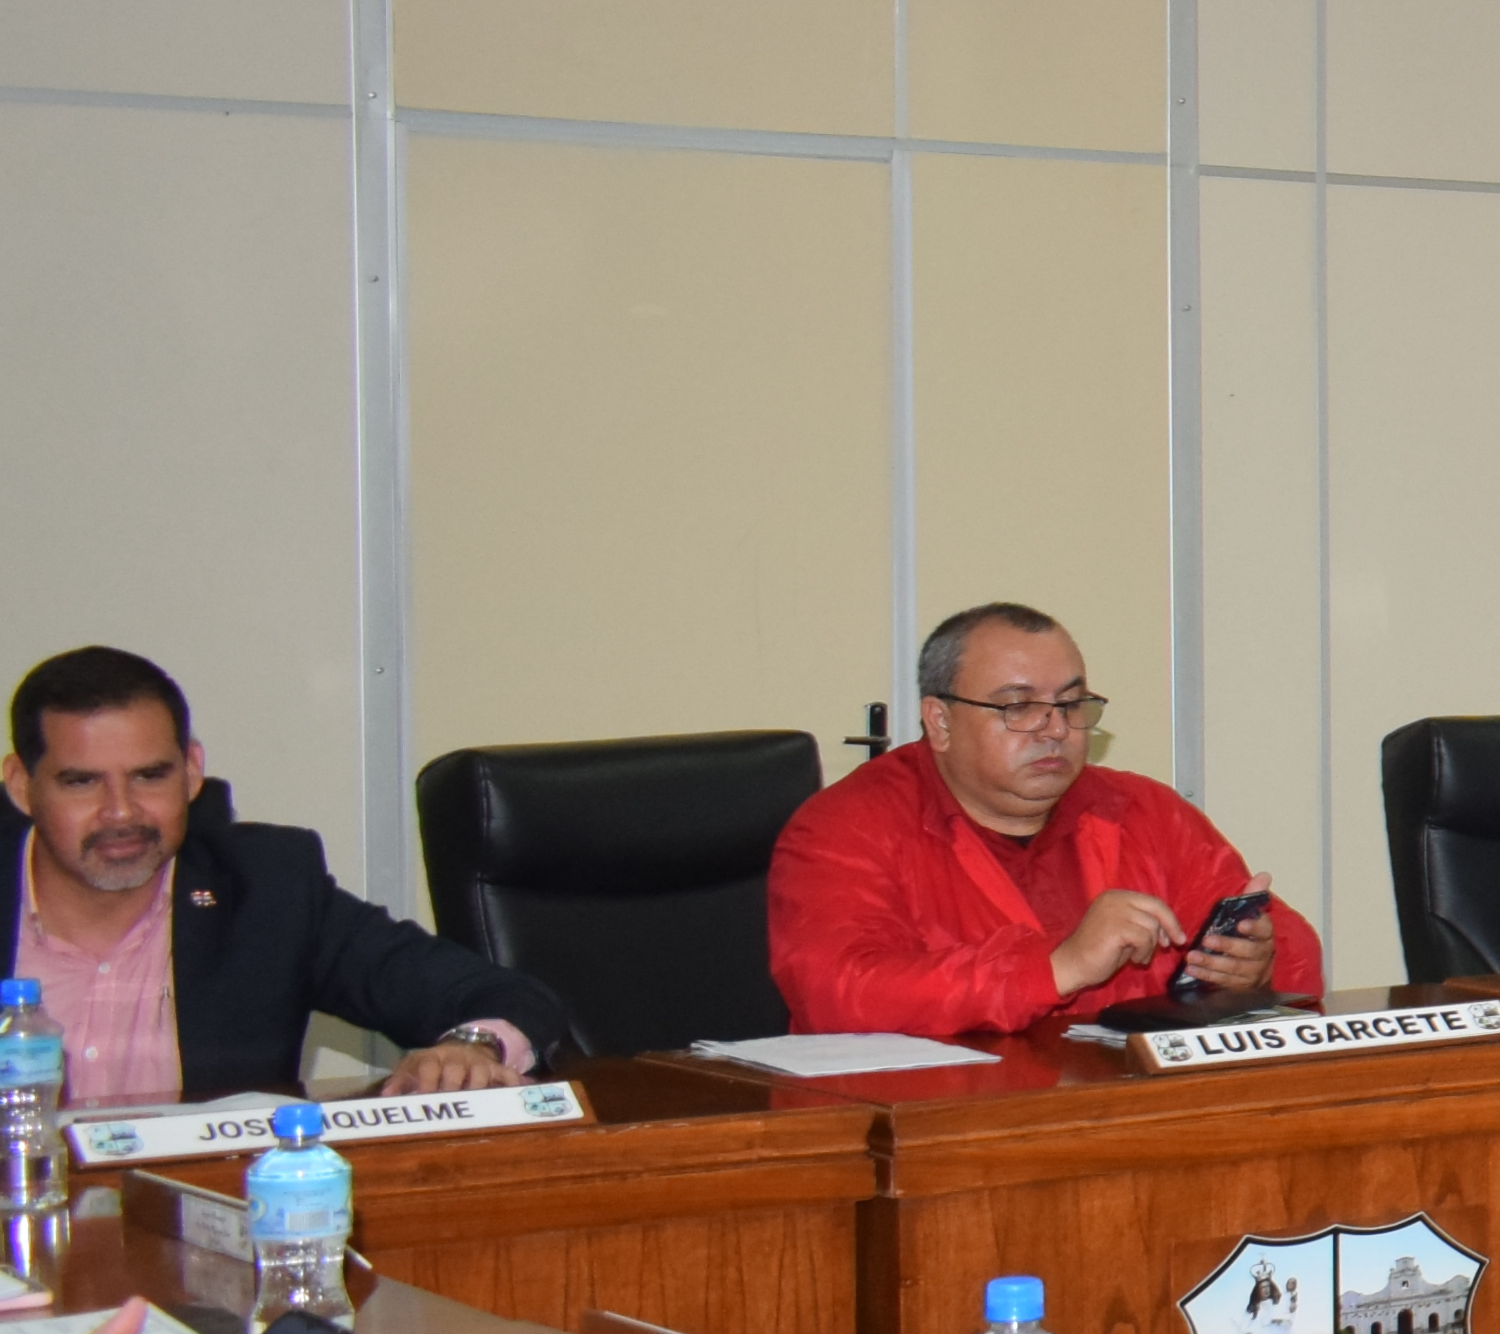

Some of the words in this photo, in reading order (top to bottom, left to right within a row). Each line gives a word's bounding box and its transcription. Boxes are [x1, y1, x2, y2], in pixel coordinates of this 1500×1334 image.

[1195, 1027, 1287, 1055] LUIS
[1295, 1010, 1468, 1045] GARCETE
[199, 1113, 276, 1142] JOS
[321, 1100, 475, 1130] IQUELME
